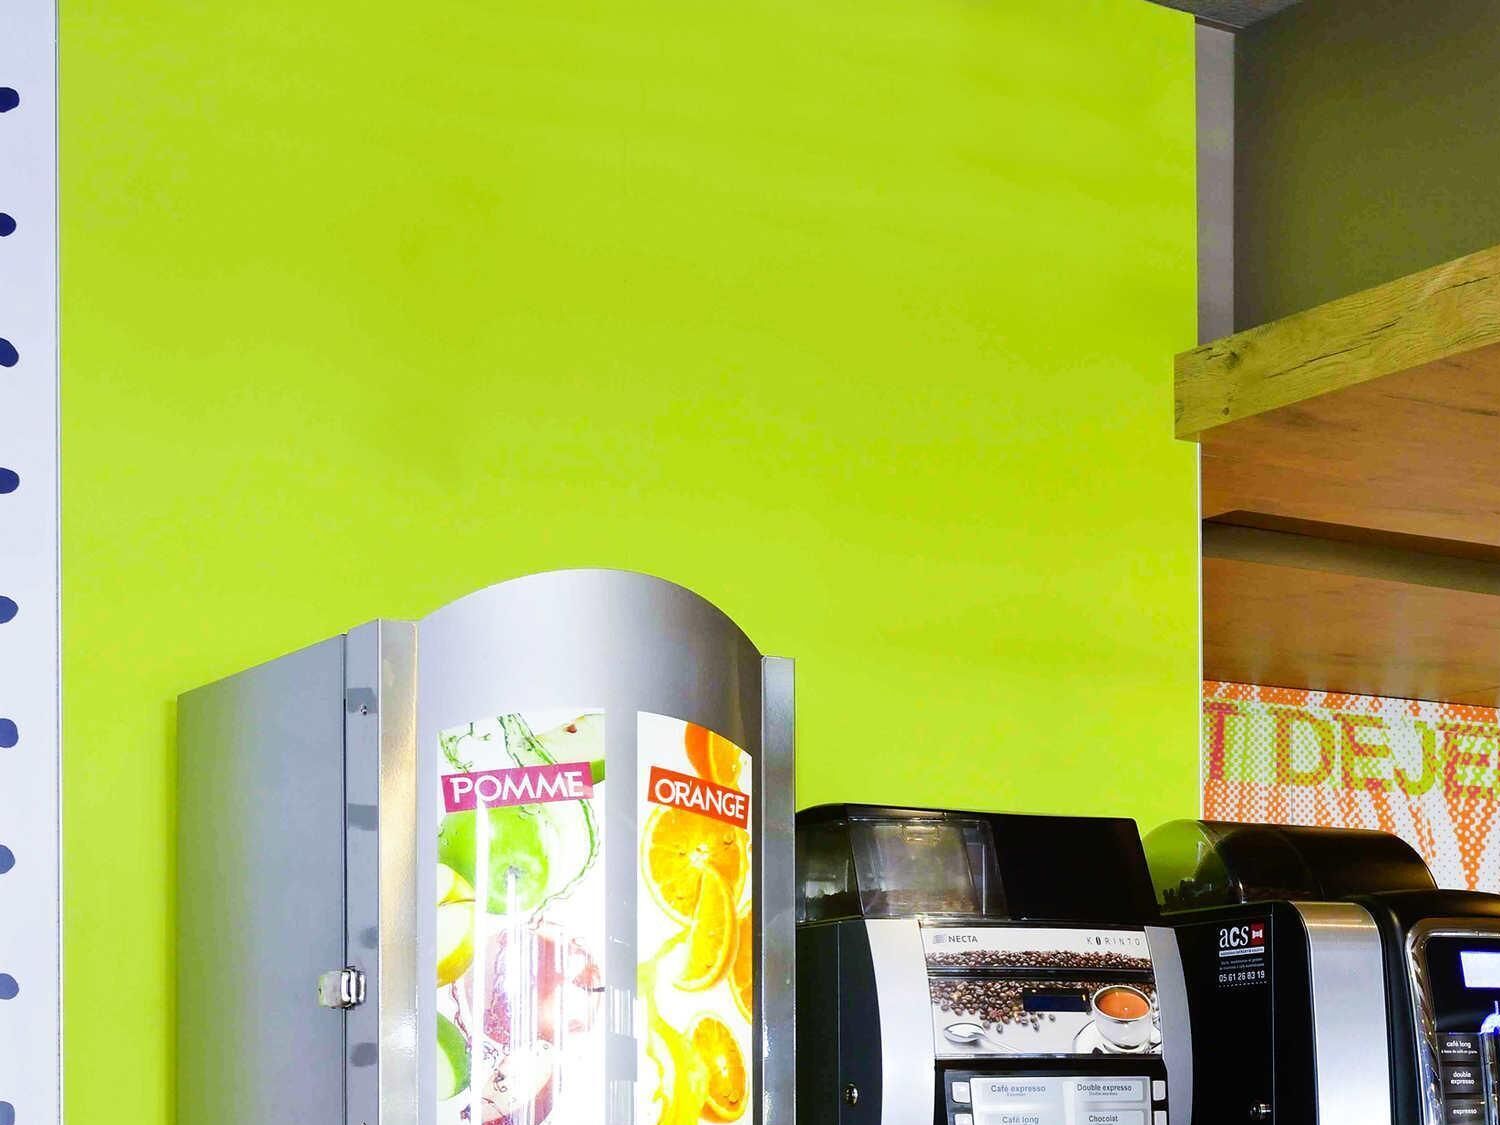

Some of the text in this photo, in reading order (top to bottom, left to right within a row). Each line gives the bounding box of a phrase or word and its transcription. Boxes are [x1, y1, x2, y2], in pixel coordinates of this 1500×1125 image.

[449, 771, 584, 804] POMME
[654, 778, 745, 820] ORANGE
[947, 934, 978, 944] NECTA
[1219, 926, 1249, 948] acs
[1219, 973, 1228, 983] 05
[1257, 970, 1265, 979] 19
[1076, 1083, 1101, 1091] Double
[1021, 1115, 1040, 1125] long
[1088, 1114, 1119, 1123] Chocolat
